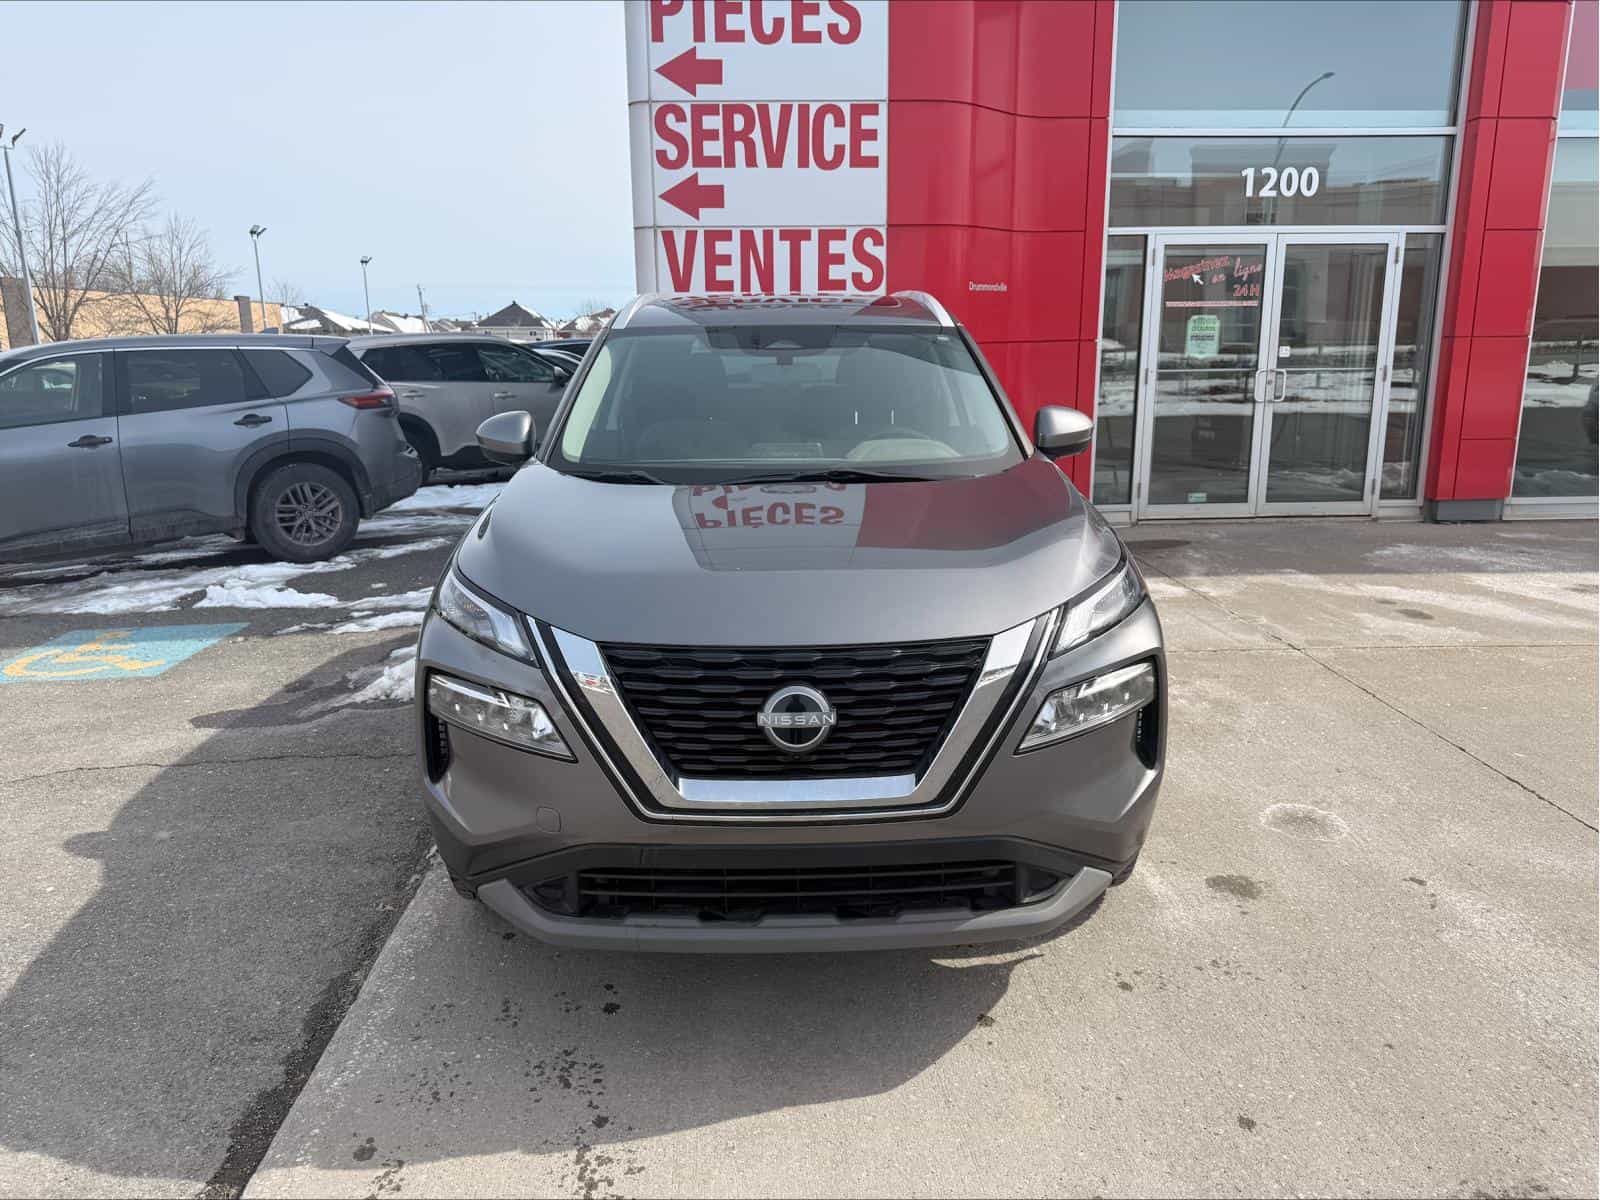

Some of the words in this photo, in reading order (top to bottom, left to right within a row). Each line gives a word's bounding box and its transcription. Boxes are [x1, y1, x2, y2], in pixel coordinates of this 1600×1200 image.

[654, 102, 881, 171] SERVICE
[1241, 166, 1320, 198] 1200
[661, 227, 885, 294] VENTES
[1233, 256, 1263, 281] ligne
[759, 714, 834, 726] NISSAN
